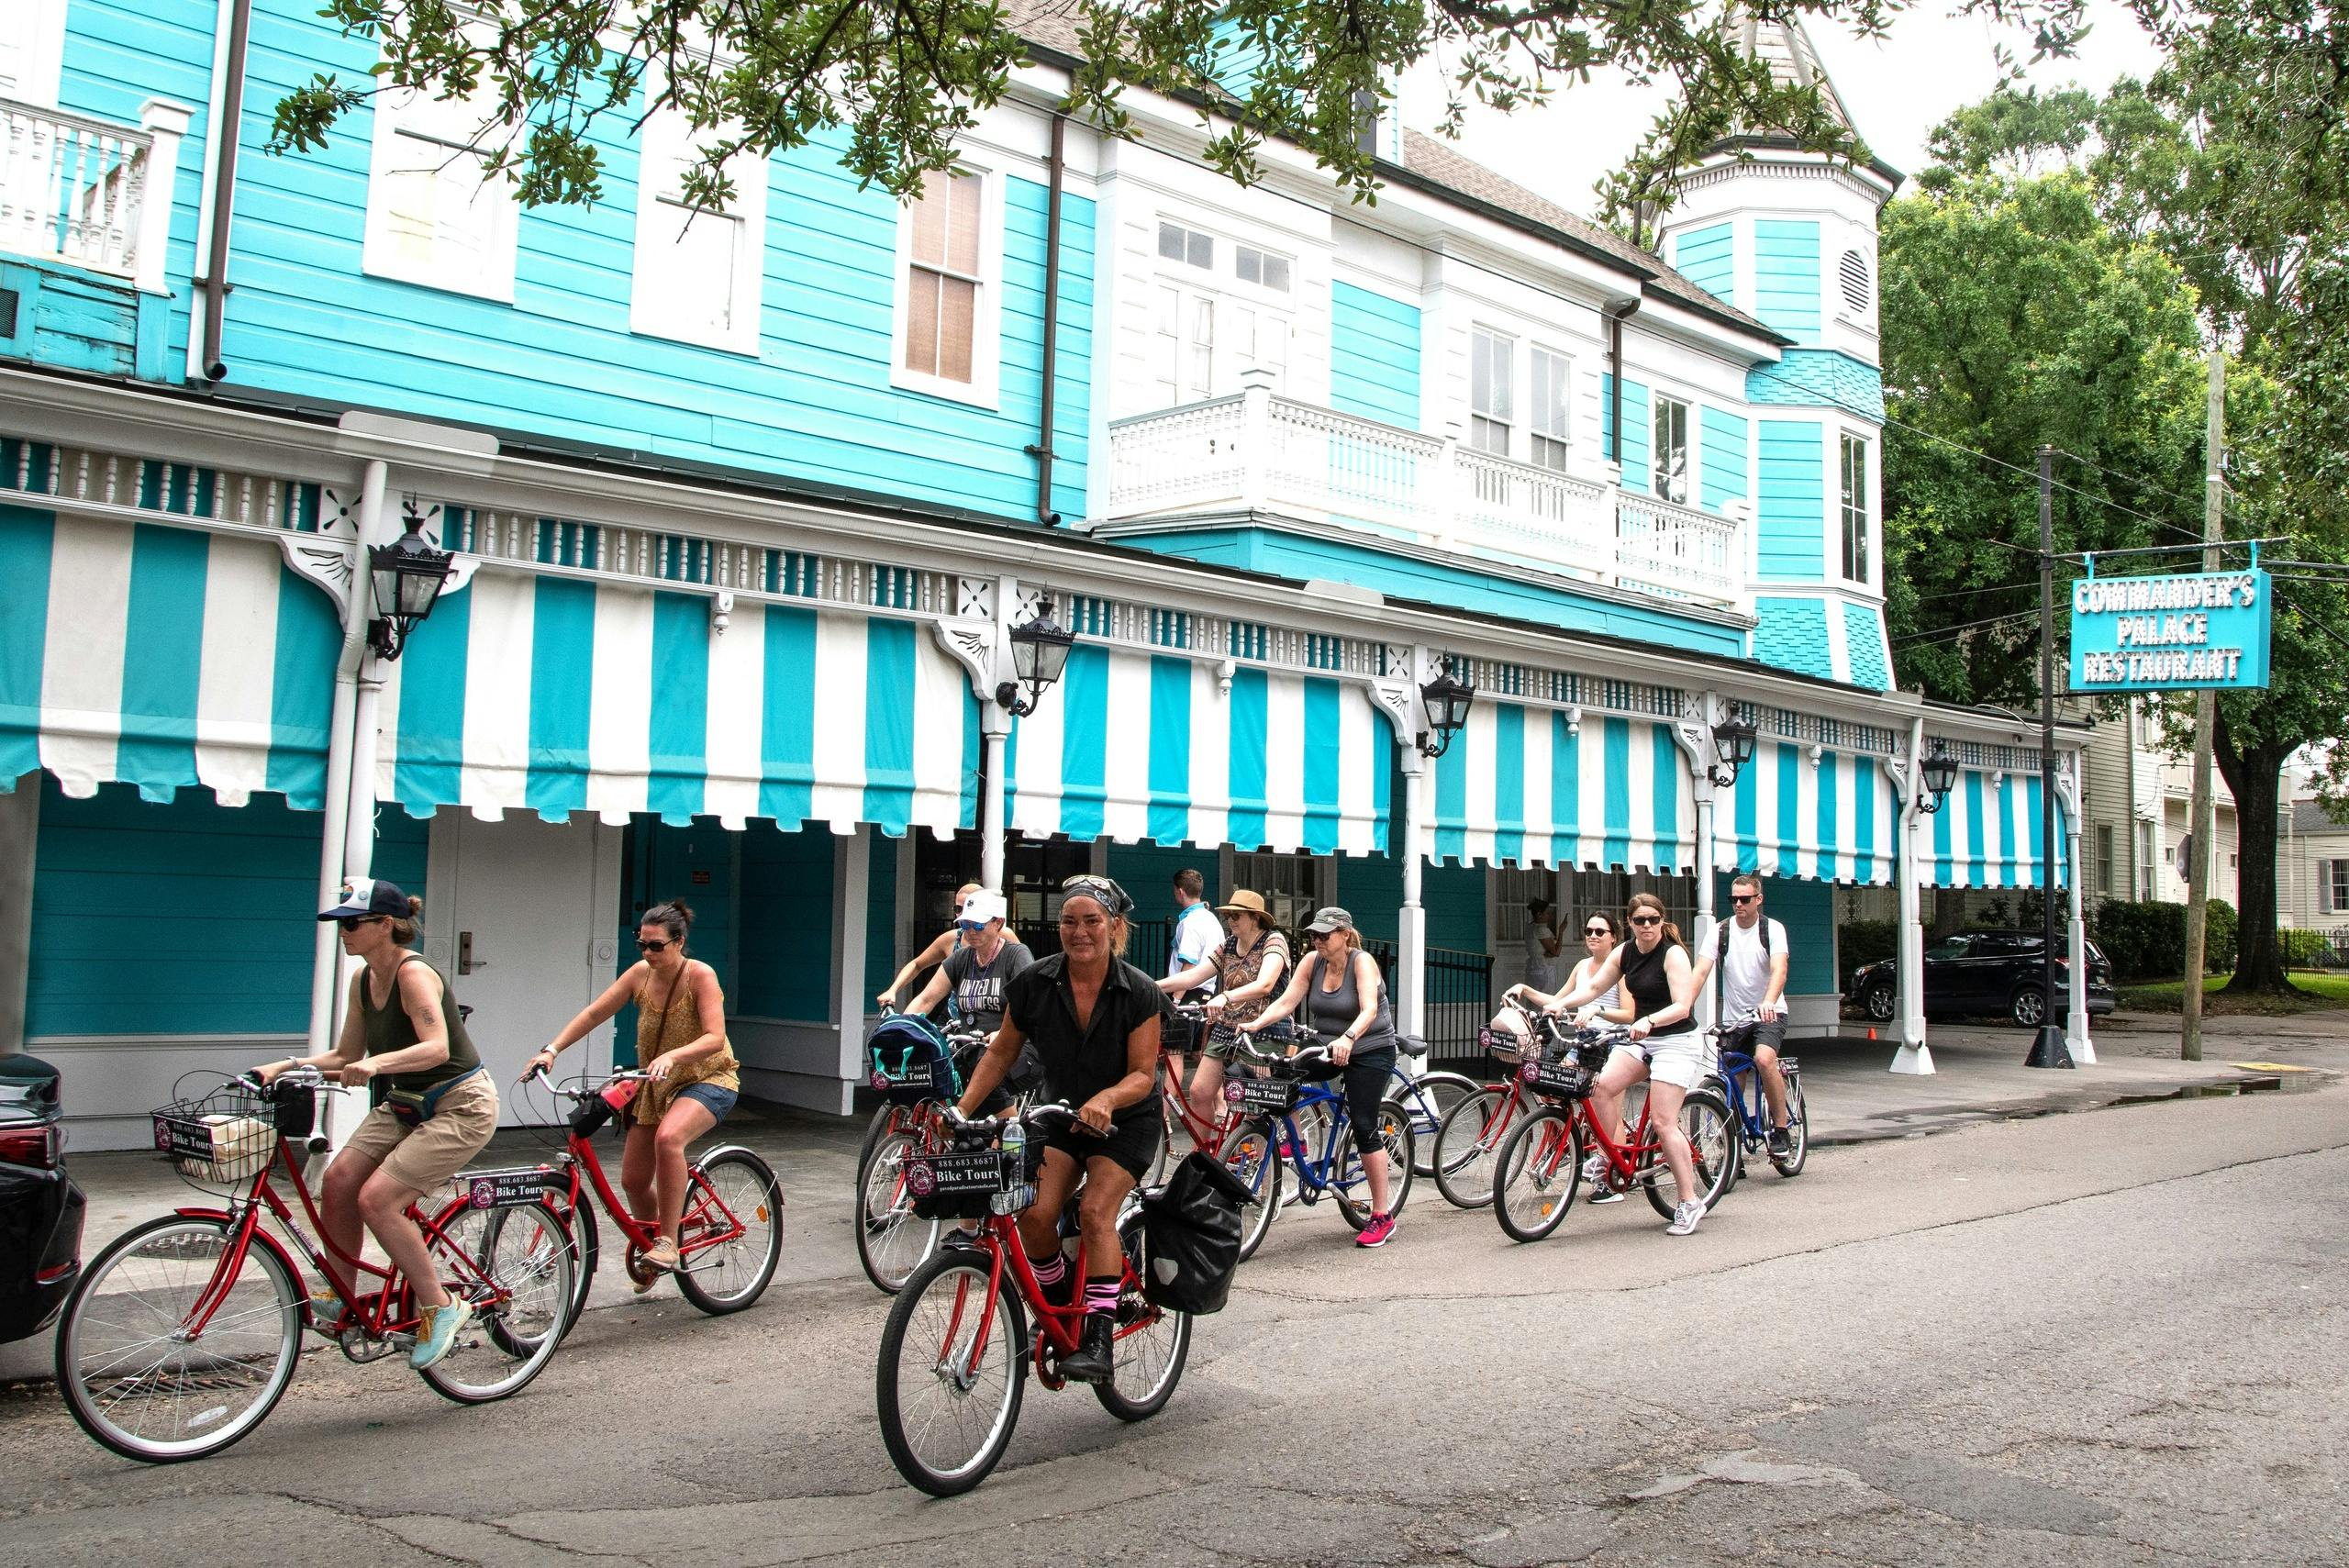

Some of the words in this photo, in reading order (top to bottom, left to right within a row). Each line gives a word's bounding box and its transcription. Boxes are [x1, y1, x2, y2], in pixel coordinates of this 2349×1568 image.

[2075, 574, 2254, 614] COMMANDER'S
[2117, 613, 2208, 646] PALACE
[2083, 648, 2242, 683] RESTAURANT
[959, 978, 990, 996] UNITED
[991, 977, 1001, 996] IN
[907, 1073, 930, 1081] Tours
[1539, 1070, 1554, 1079] Bike
[1555, 1073, 1576, 1083] Tours
[1245, 1088, 1262, 1096] Bike
[1264, 1091, 1286, 1099] Tours
[173, 1132, 189, 1145] Bike
[190, 1137, 213, 1151] Tours
[938, 1157, 993, 1167] 888.683.8687
[498, 1175, 540, 1184] 888.683.8687
[936, 1170, 962, 1183] Bike
[963, 1169, 1000, 1181] Tours
[496, 1187, 517, 1196] Bike
[518, 1185, 543, 1195] Tours
